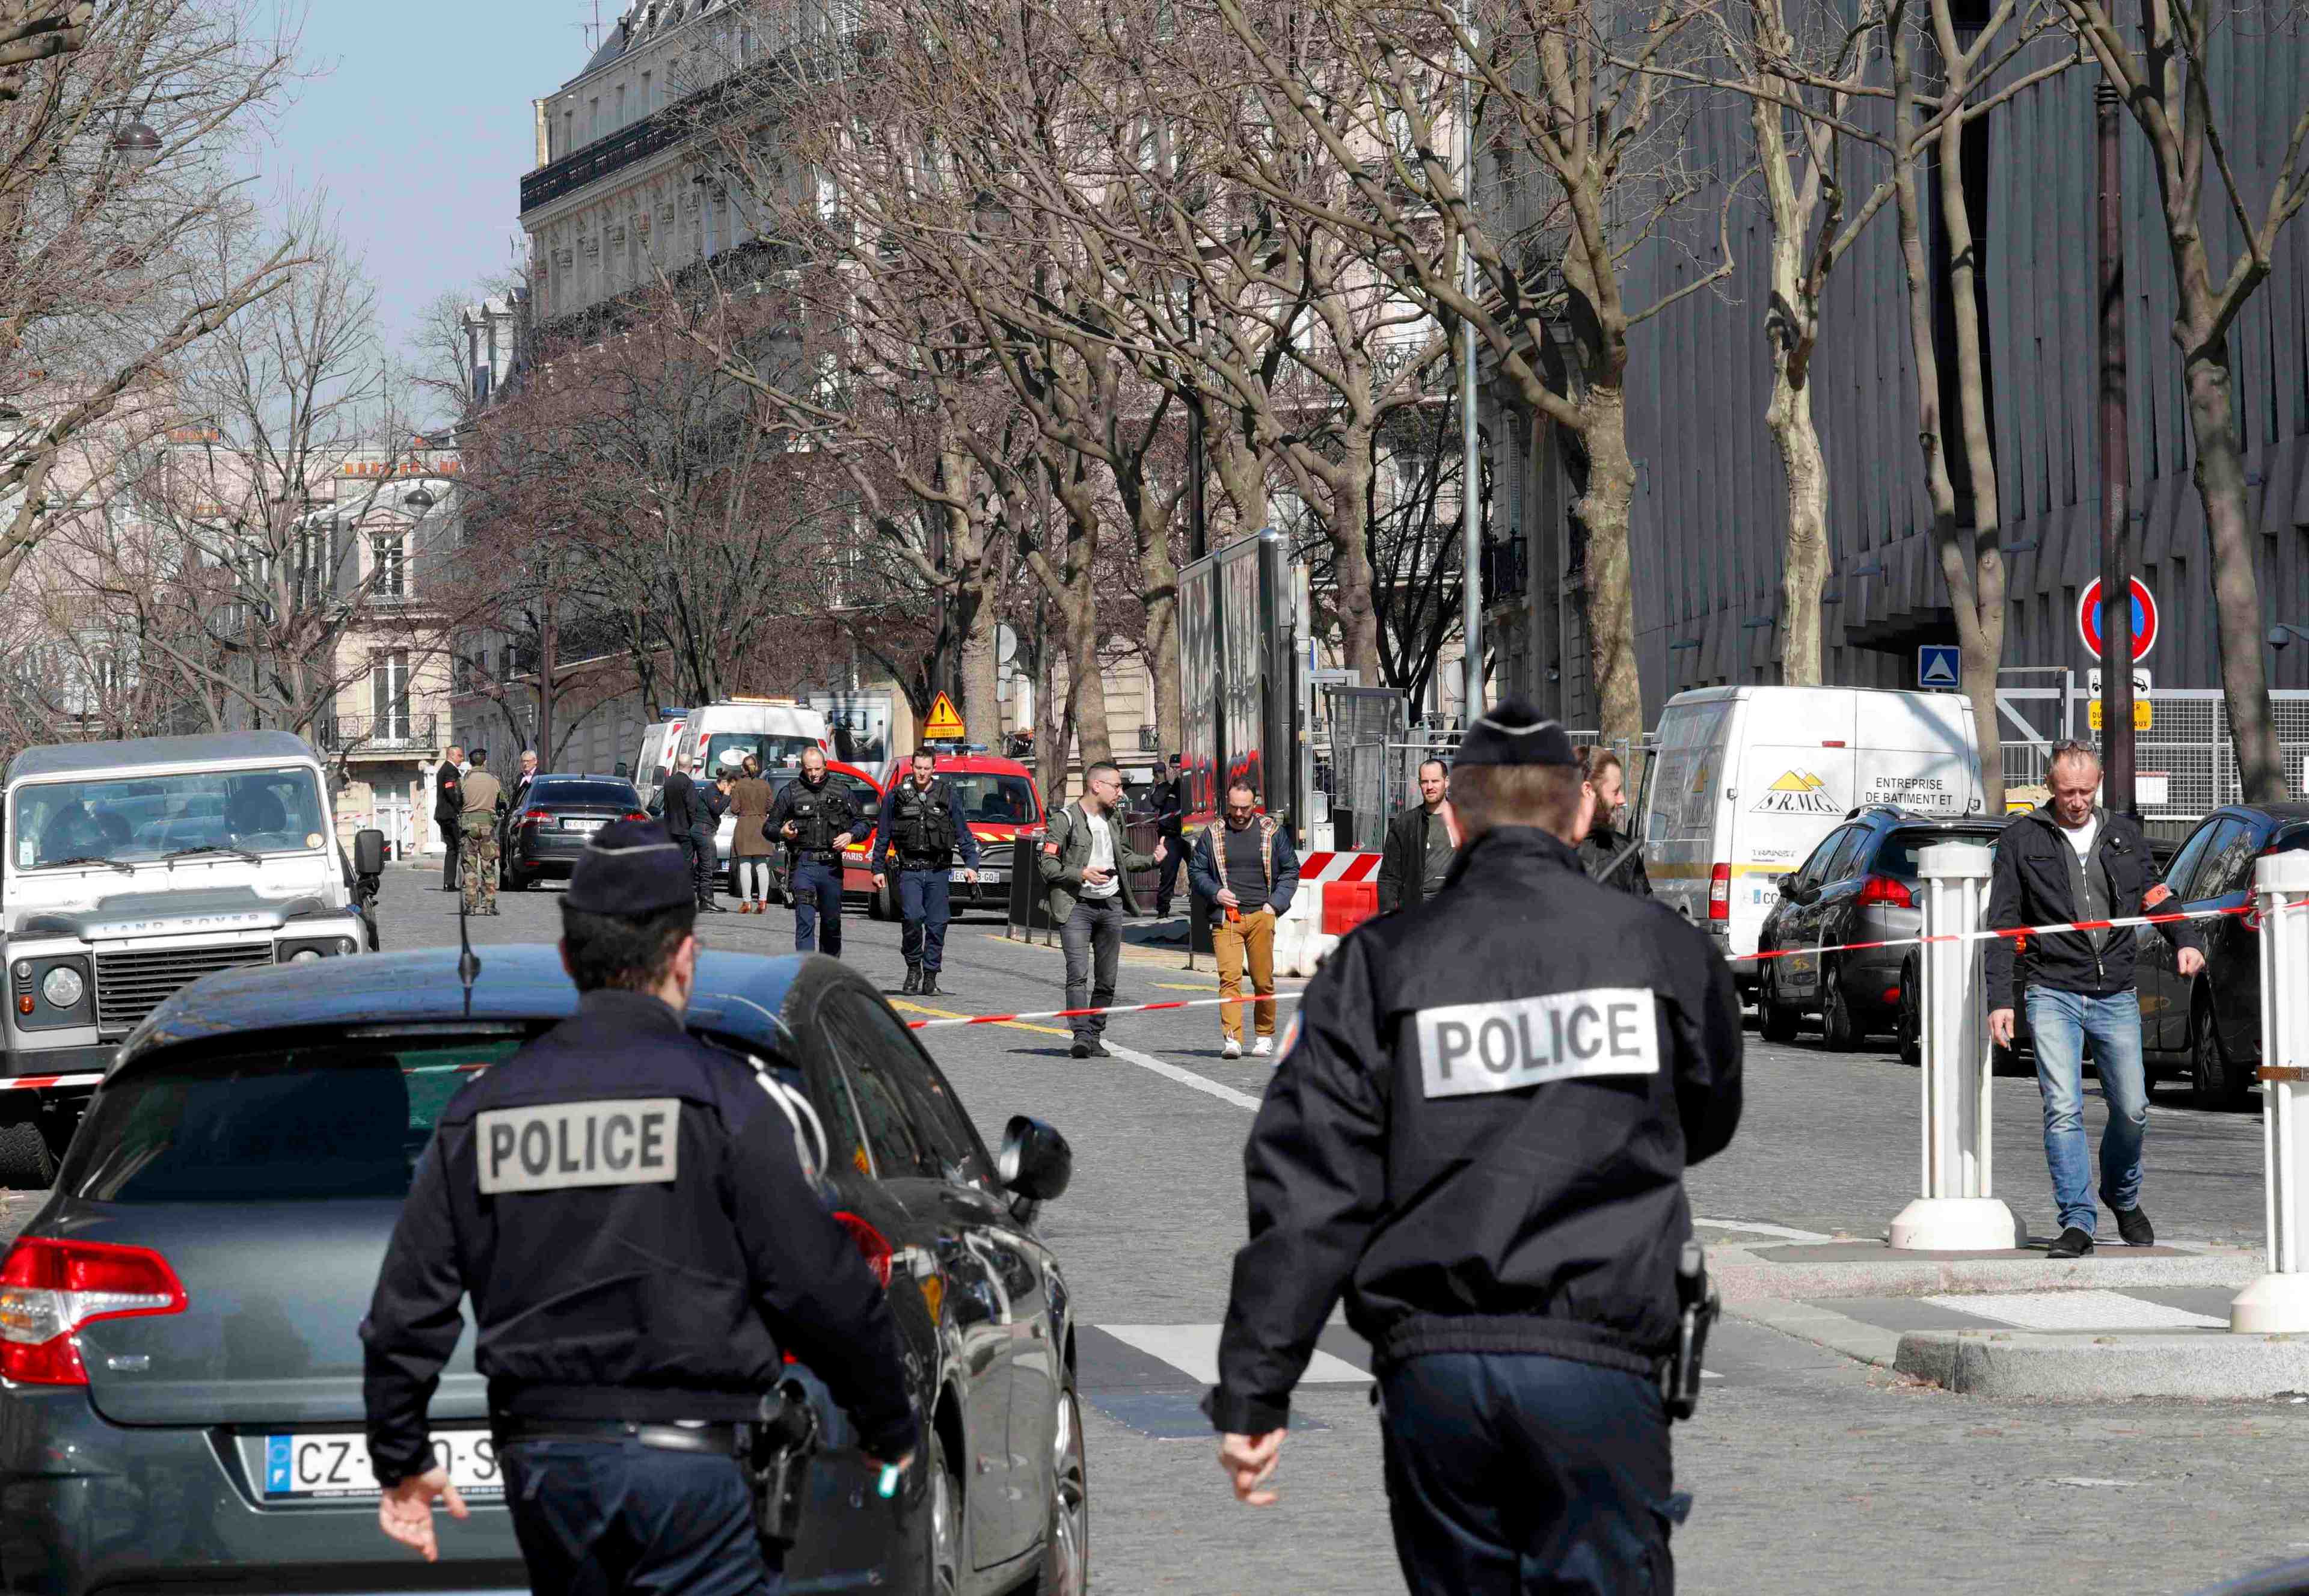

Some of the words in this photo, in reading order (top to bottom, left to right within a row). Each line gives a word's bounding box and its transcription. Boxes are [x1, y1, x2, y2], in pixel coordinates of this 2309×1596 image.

[1875, 777, 1943, 790] ENTREPRISE
[1866, 791, 1880, 802] DE
[1883, 793, 1936, 804] BATIMENT
[1939, 794, 1953, 805] ET
[842, 851, 863, 862] PARIS
[103, 921, 164, 933] LAND
[1436, 1003, 1641, 1079] POLICE
[489, 1113, 665, 1179] POLICE
